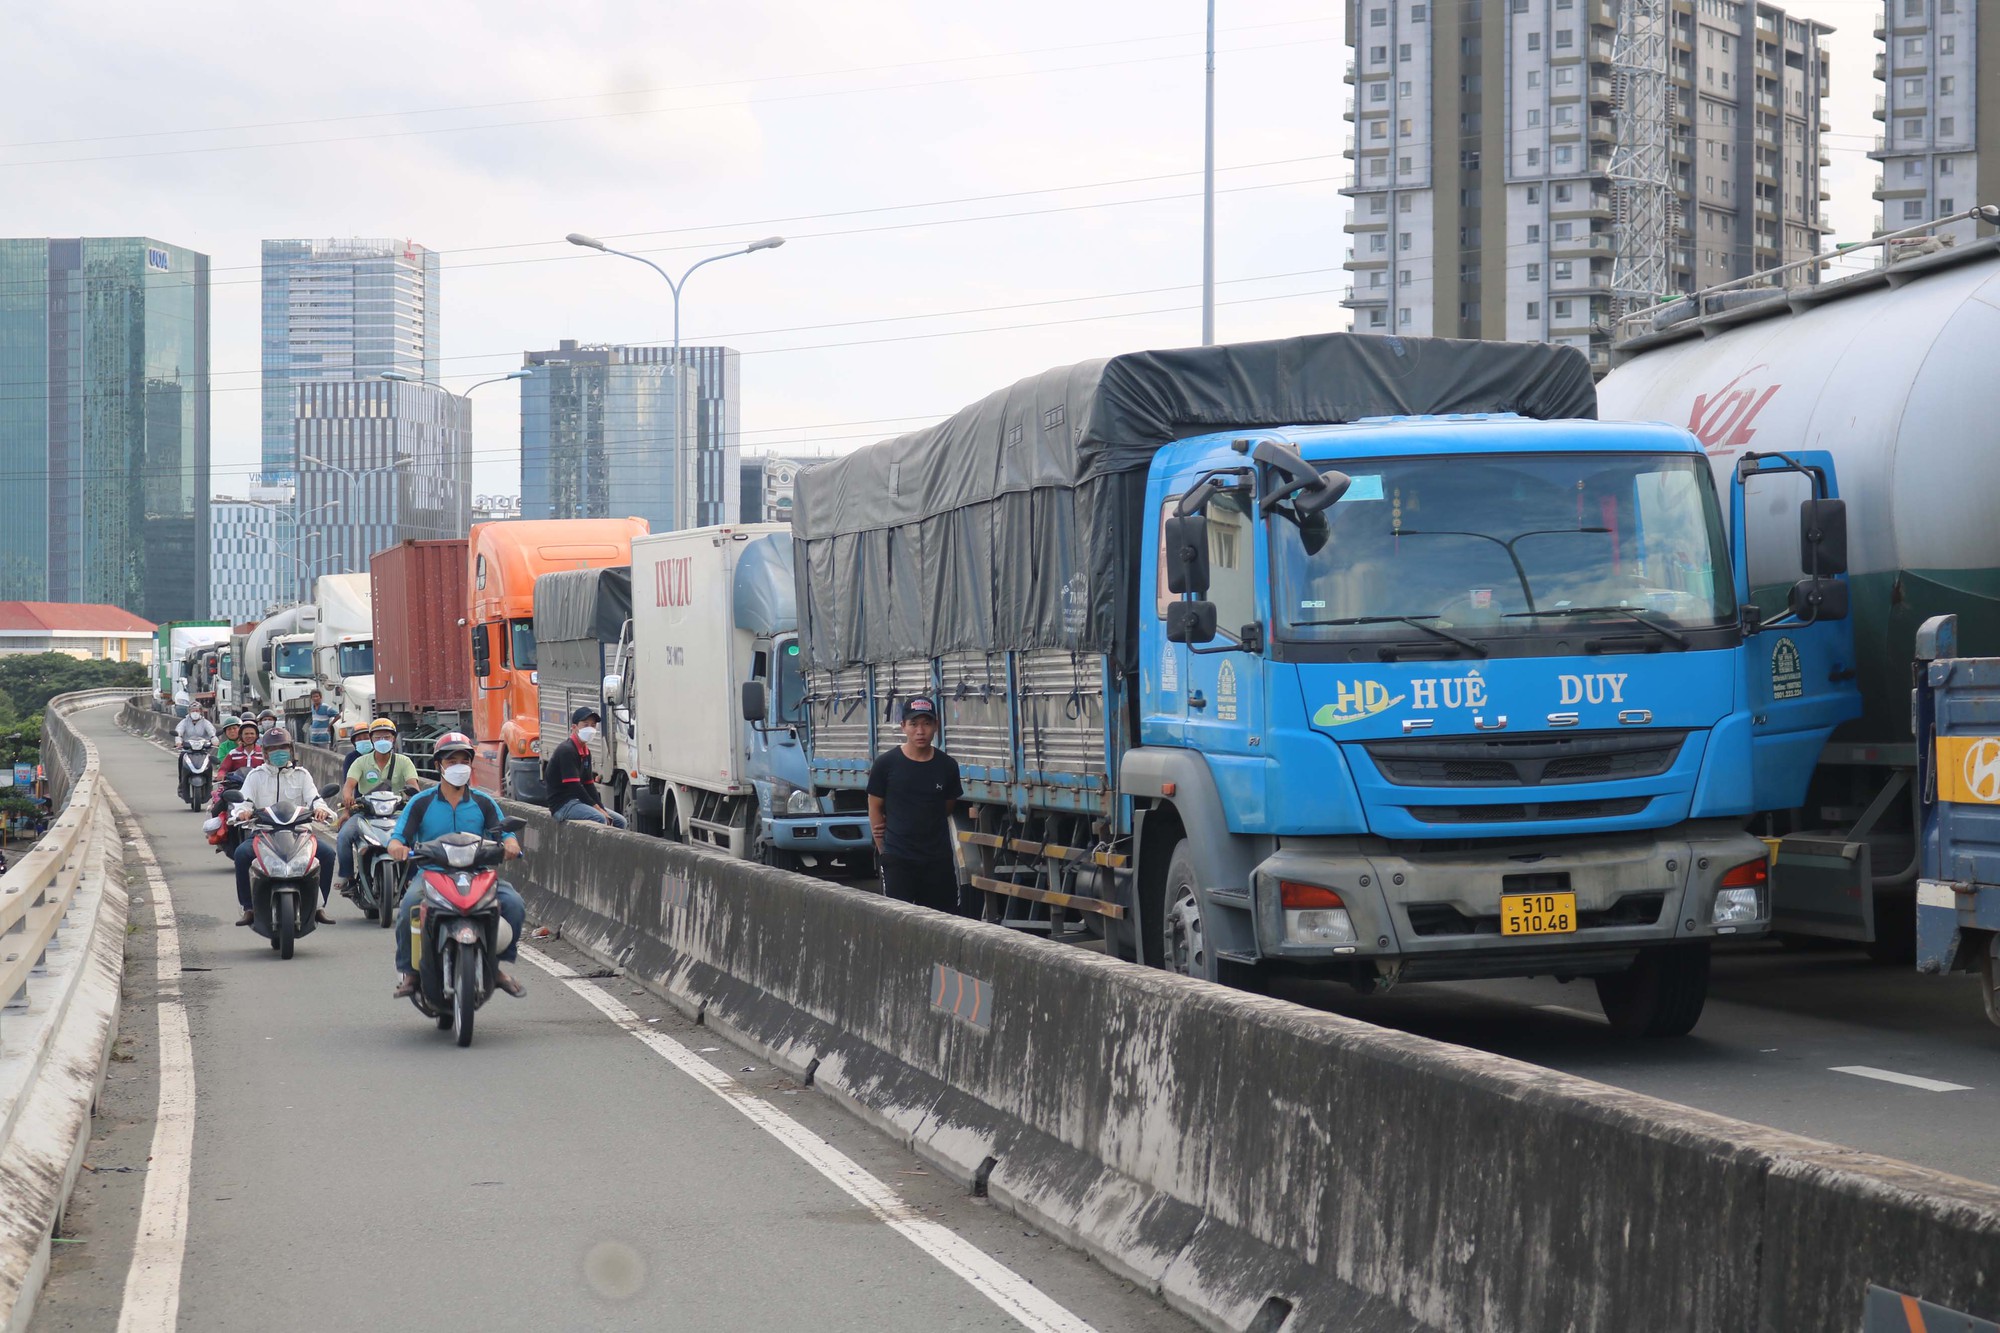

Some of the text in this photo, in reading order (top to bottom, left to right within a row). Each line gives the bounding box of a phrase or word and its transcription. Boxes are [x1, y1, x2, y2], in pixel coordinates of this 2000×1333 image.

[655, 556, 692, 608] ISUZU
[1337, 679, 1389, 713] HD
[1410, 669, 1628, 714] HUỆ DUY
[1401, 709, 1653, 733] FUSO
[1523, 896, 1554, 913] 51D
[1510, 914, 1568, 933] 510.48
